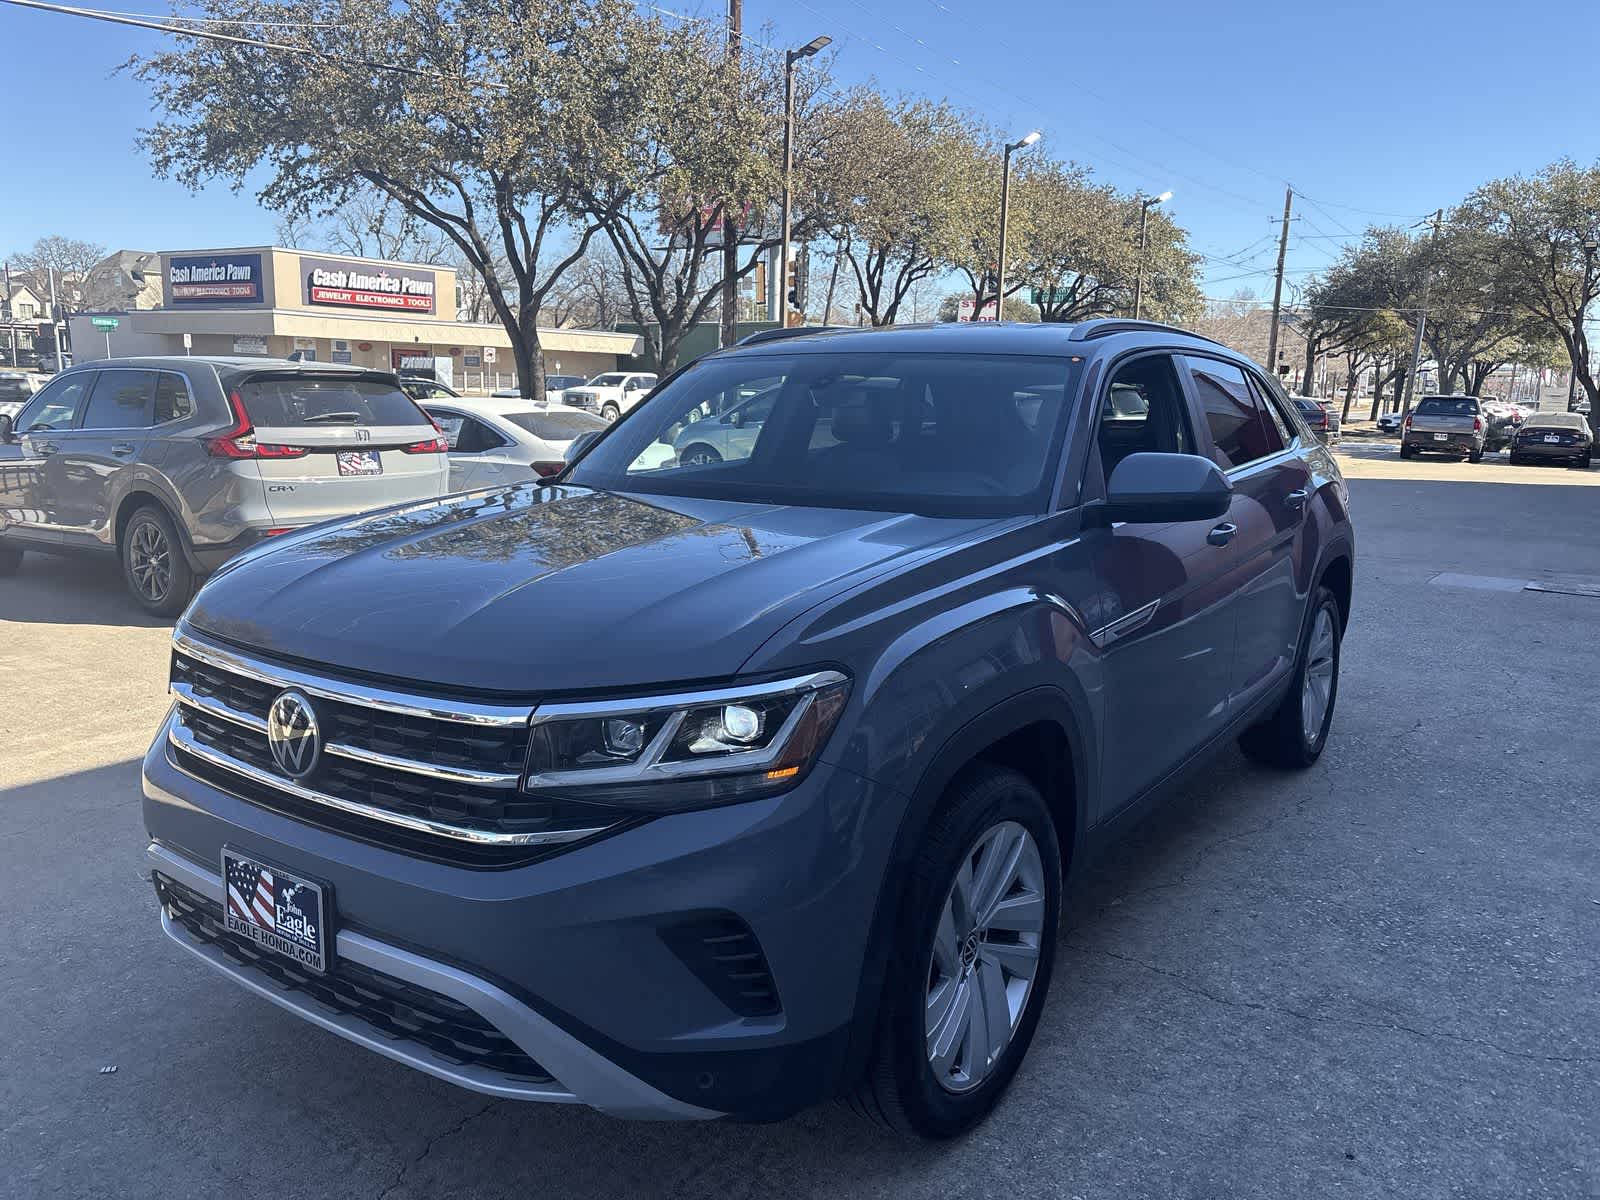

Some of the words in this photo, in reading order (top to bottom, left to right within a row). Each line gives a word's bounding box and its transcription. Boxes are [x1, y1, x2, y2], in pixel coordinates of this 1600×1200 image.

[170, 266, 190, 282] Cash
[191, 265, 225, 282] America
[227, 264, 251, 280] Pawn
[313, 268, 347, 288] Cash
[348, 271, 400, 292] America
[401, 277, 433, 295] Pawn
[317, 290, 352, 301] JEWELRY
[355, 294, 404, 305] ELECTRONICS
[407, 298, 431, 307] TOOLS
[286, 903, 302, 915] John
[275, 904, 315, 939] Eagle
[228, 919, 259, 939] EAGLE
[261, 935, 321, 969] HONDA.COM
